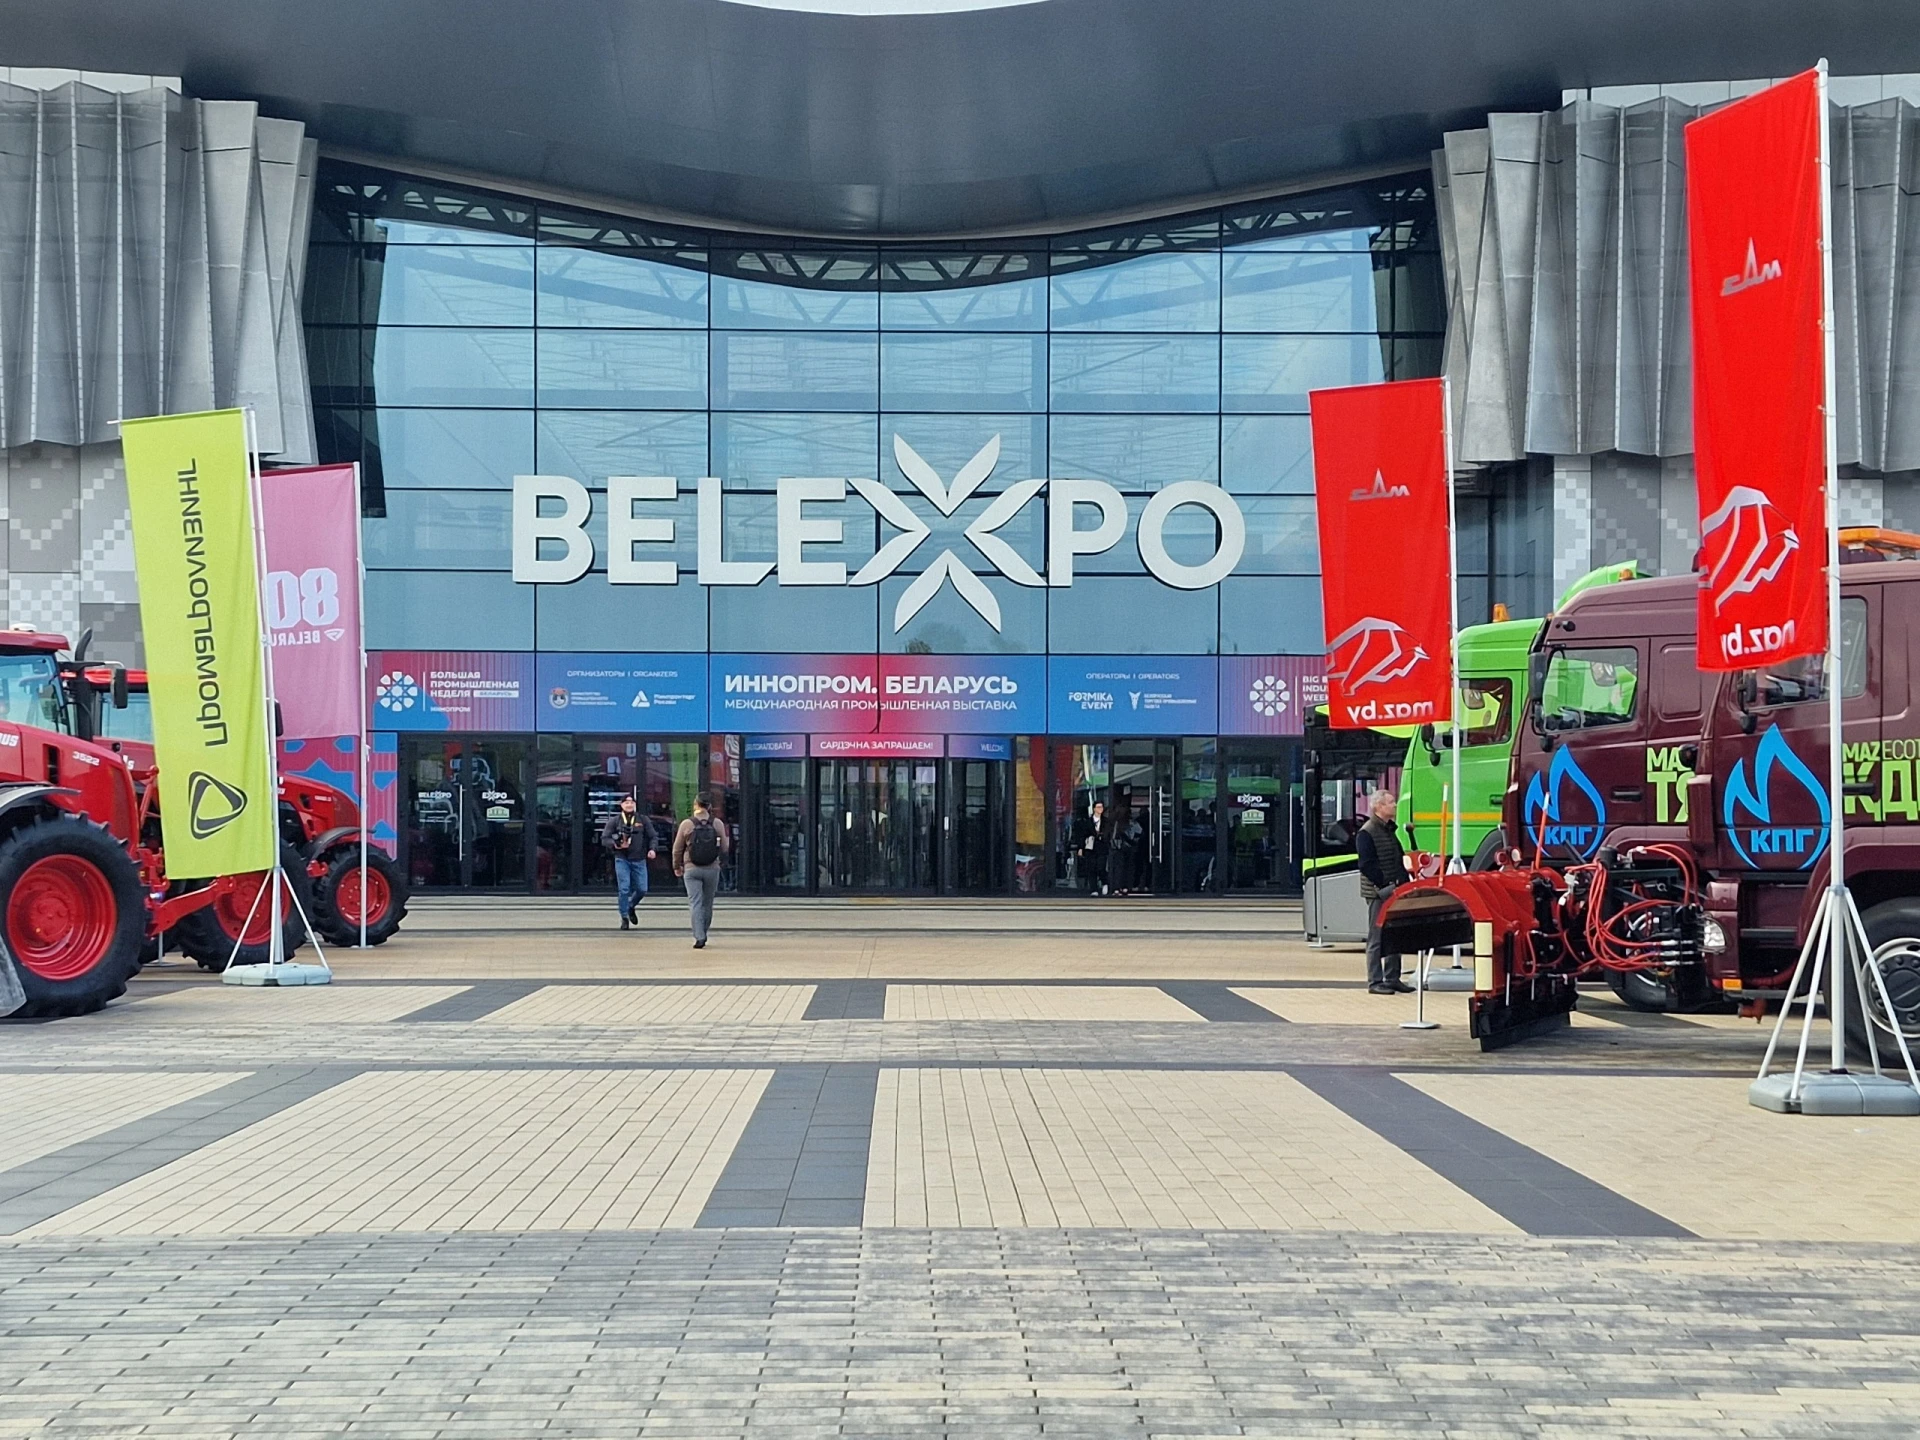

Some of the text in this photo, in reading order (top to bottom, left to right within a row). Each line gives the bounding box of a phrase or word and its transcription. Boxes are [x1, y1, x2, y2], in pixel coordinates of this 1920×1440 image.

[512, 433, 1246, 634] BELEXPO
[430, 671, 481, 679] БОЛЬШАЯ
[566, 670, 625, 678] ОРГАНИЗАТОРЫ
[632, 670, 678, 678] ORGANIZERS
[430, 681, 519, 689] ПРОМЫШЛЕННАЯ
[725, 675, 1018, 694] ИННОПРОМ. БЕЛАРУСЬ
[430, 690, 471, 698] НЕДЕЛЯ
[1069, 692, 1113, 701] FORMIKA
[724, 699, 1018, 711] МЕЖДУНАРОДНАЯ ПРОМЫШЛЕННАЯ ВЫСТАВКА
[1081, 702, 1113, 710] EVENT
[820, 741, 934, 750] САРДЭЧНА ЗАПРАШАЕМ!
[1544, 826, 1593, 846] КПГ
[1751, 828, 1815, 853] КПГ
